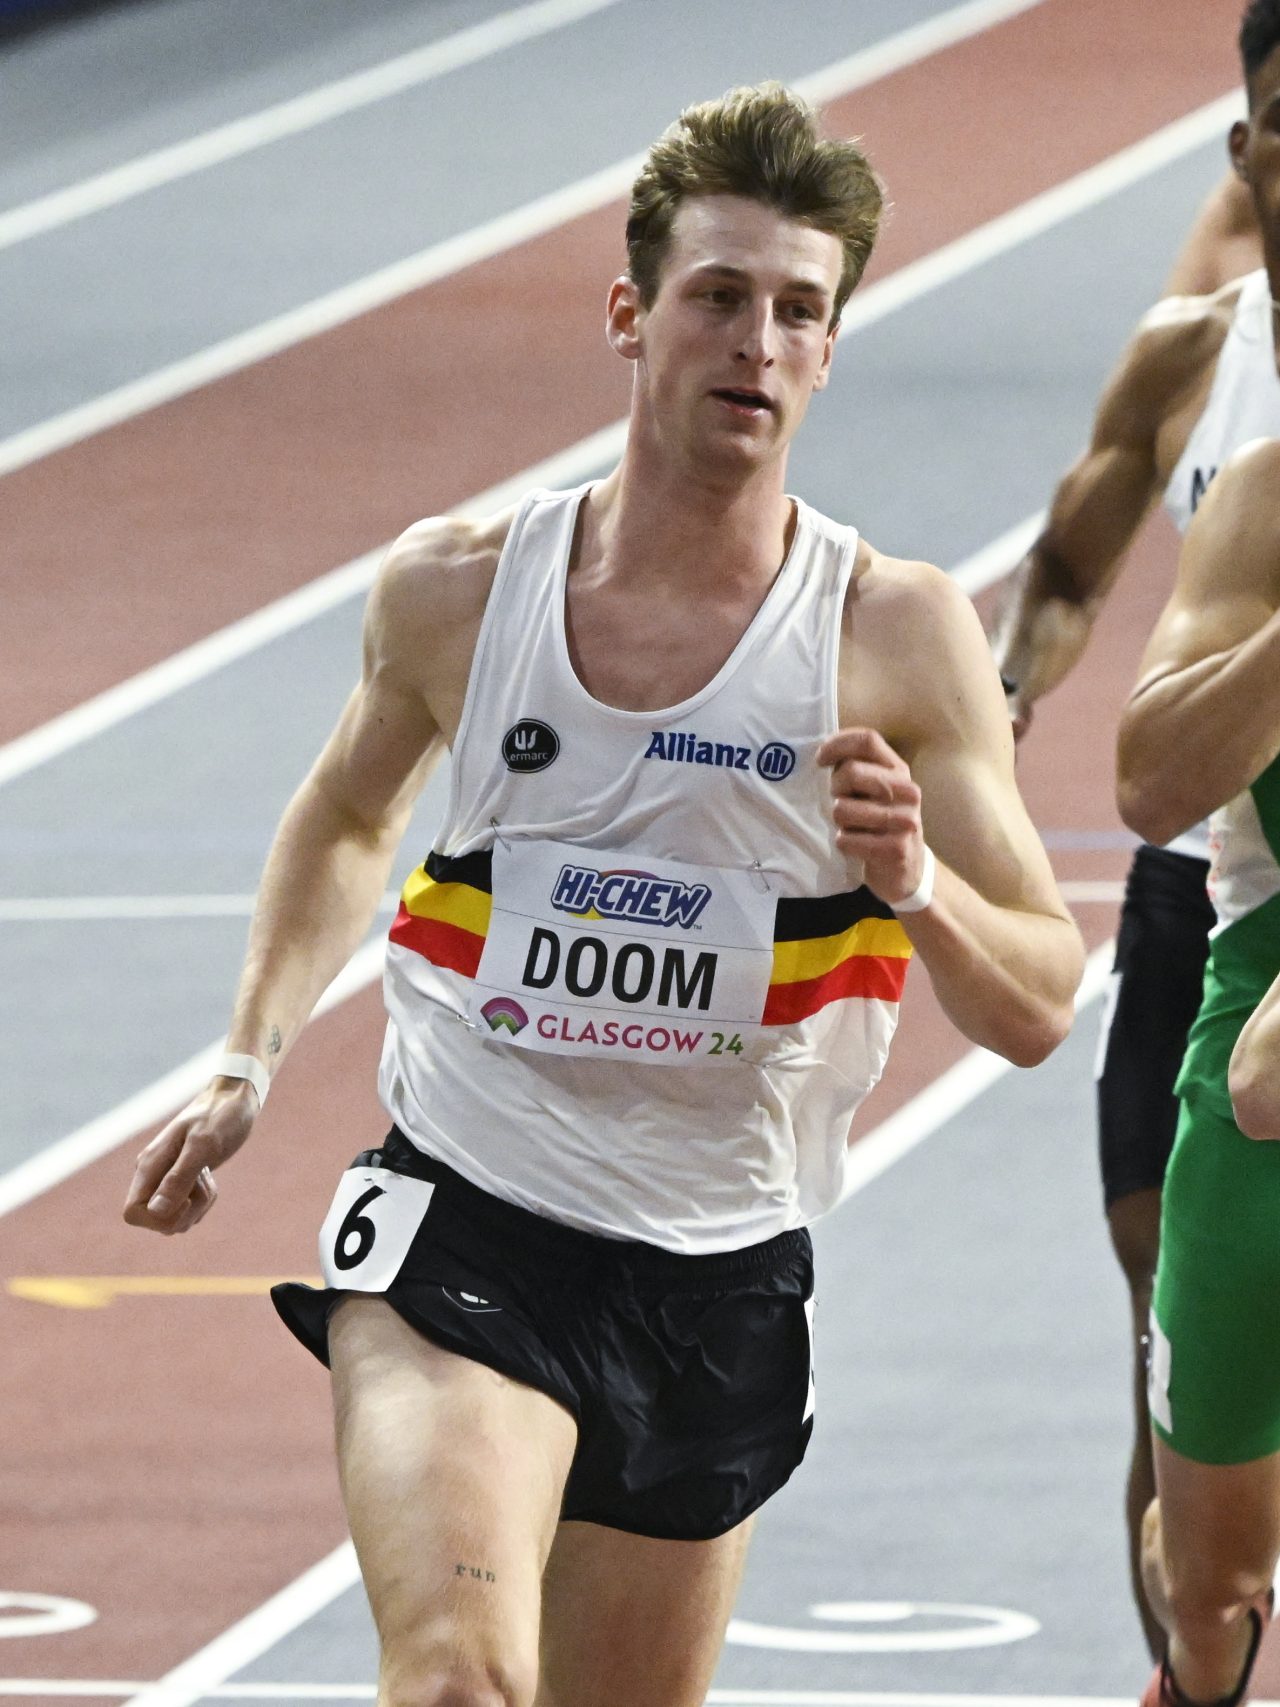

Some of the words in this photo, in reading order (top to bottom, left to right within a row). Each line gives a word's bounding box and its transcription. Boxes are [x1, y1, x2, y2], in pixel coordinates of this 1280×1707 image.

[643, 730, 751, 770] Allianz
[551, 864, 712, 929] HI-CHEW
[521, 926, 718, 1011] DOOM
[536, 1013, 704, 1054] GLASGOW
[706, 1031, 744, 1056] 24
[333, 1184, 386, 1271] 6
[453, 1563, 496, 1583] run
